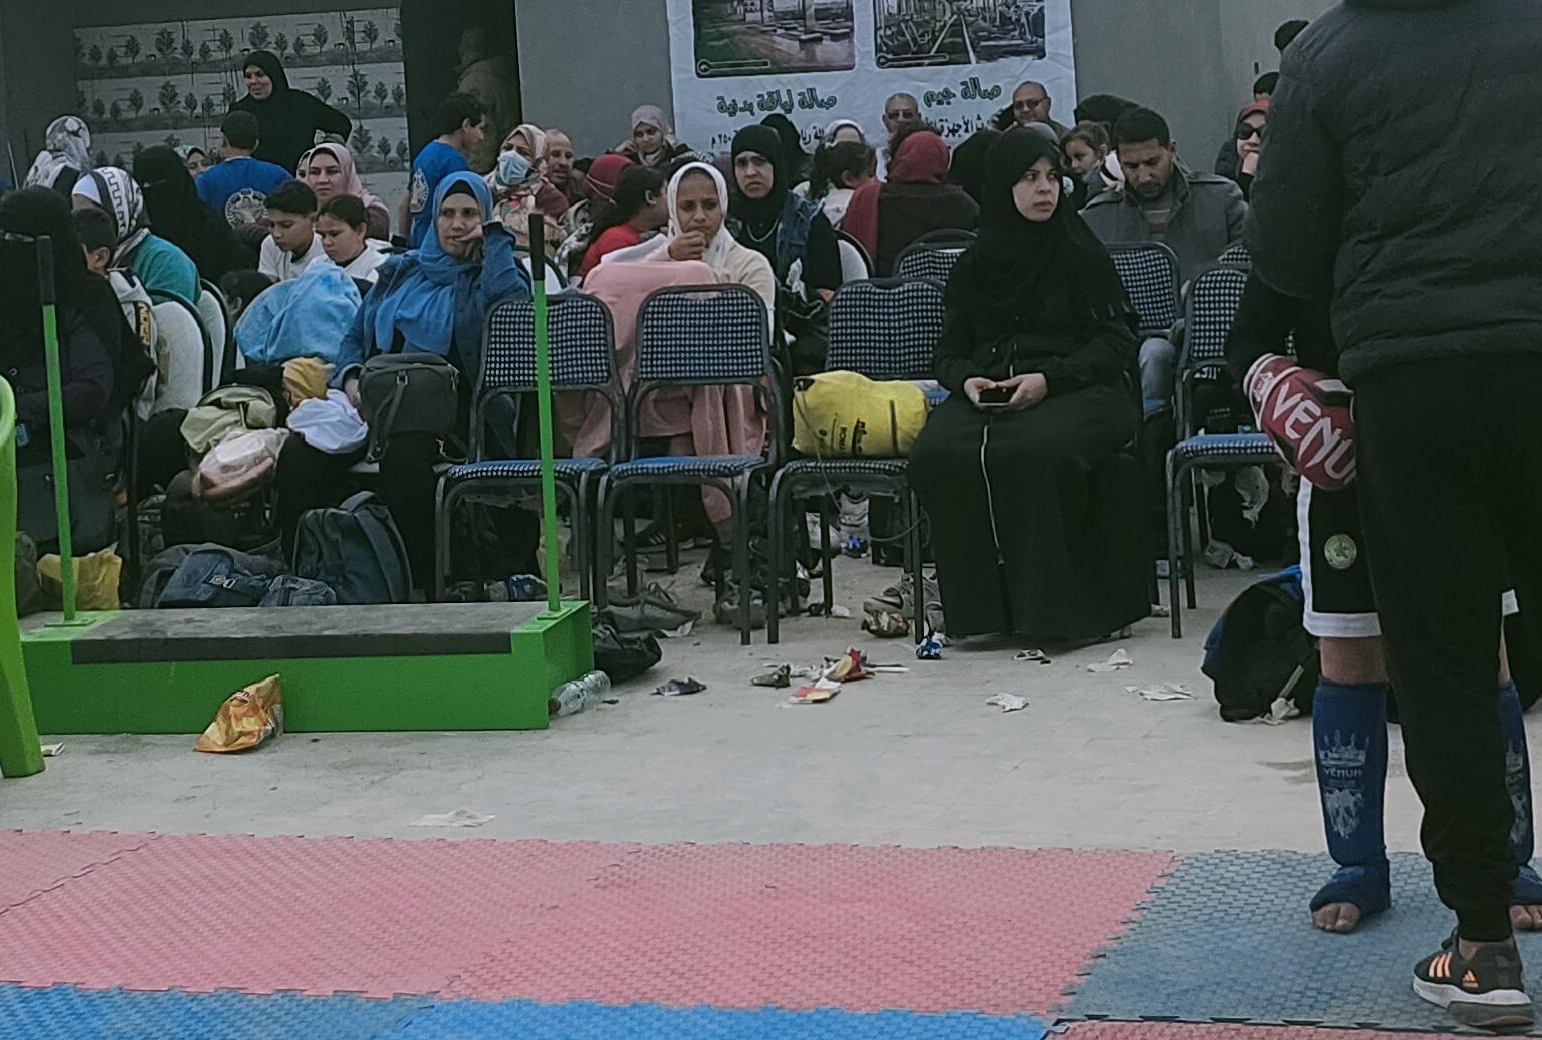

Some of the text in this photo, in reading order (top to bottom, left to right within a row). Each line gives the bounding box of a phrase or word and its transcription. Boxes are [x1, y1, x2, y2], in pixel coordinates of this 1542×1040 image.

[716, 87, 838, 117] صالة لياقة بدنية
[923, 77, 1002, 108] صالة جيم
[1272, 381, 1357, 485] VENU
